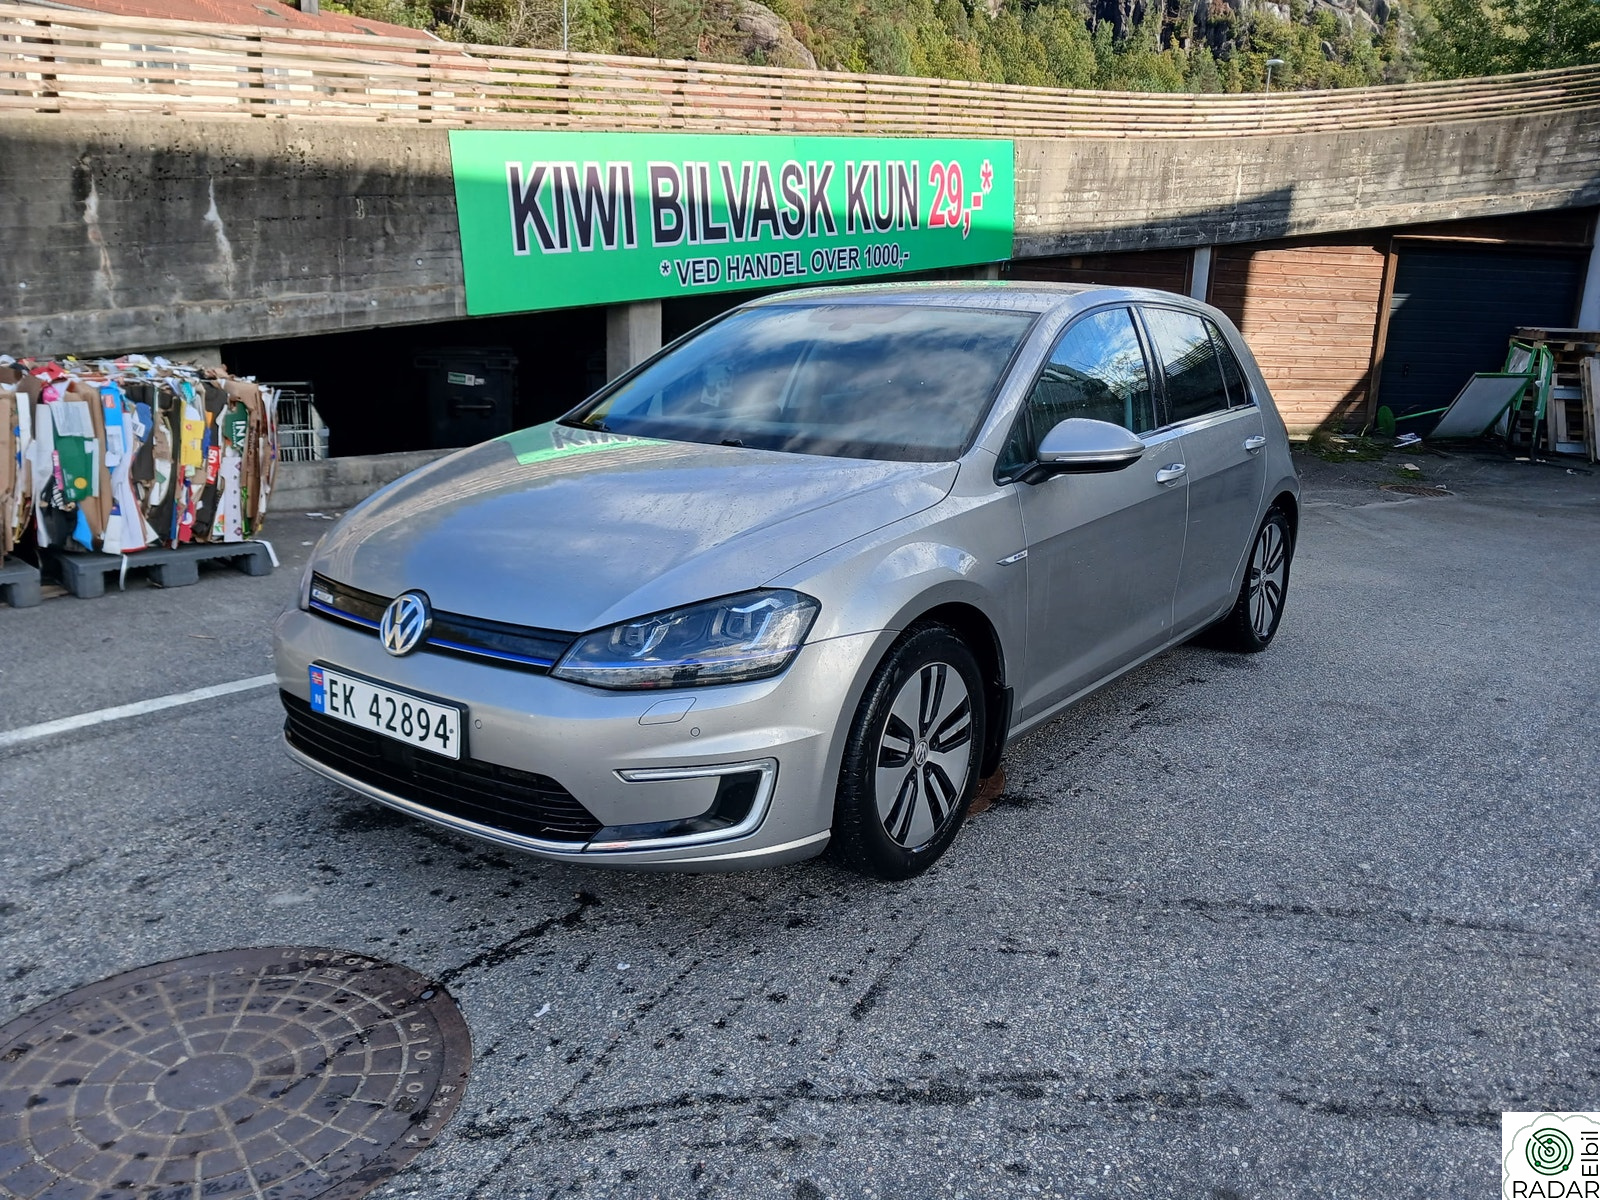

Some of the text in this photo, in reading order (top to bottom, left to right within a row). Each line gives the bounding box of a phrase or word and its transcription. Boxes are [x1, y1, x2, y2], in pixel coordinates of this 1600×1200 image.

[506, 161, 637, 255] KIWI
[646, 160, 837, 248] BILVASK
[844, 160, 920, 233] KUN
[675, 258, 721, 287] VED
[726, 251, 808, 283] HANDEL
[811, 247, 862, 275] OVER
[863, 243, 910, 271] 1000,-
[329, 678, 450, 749] EK 42894
